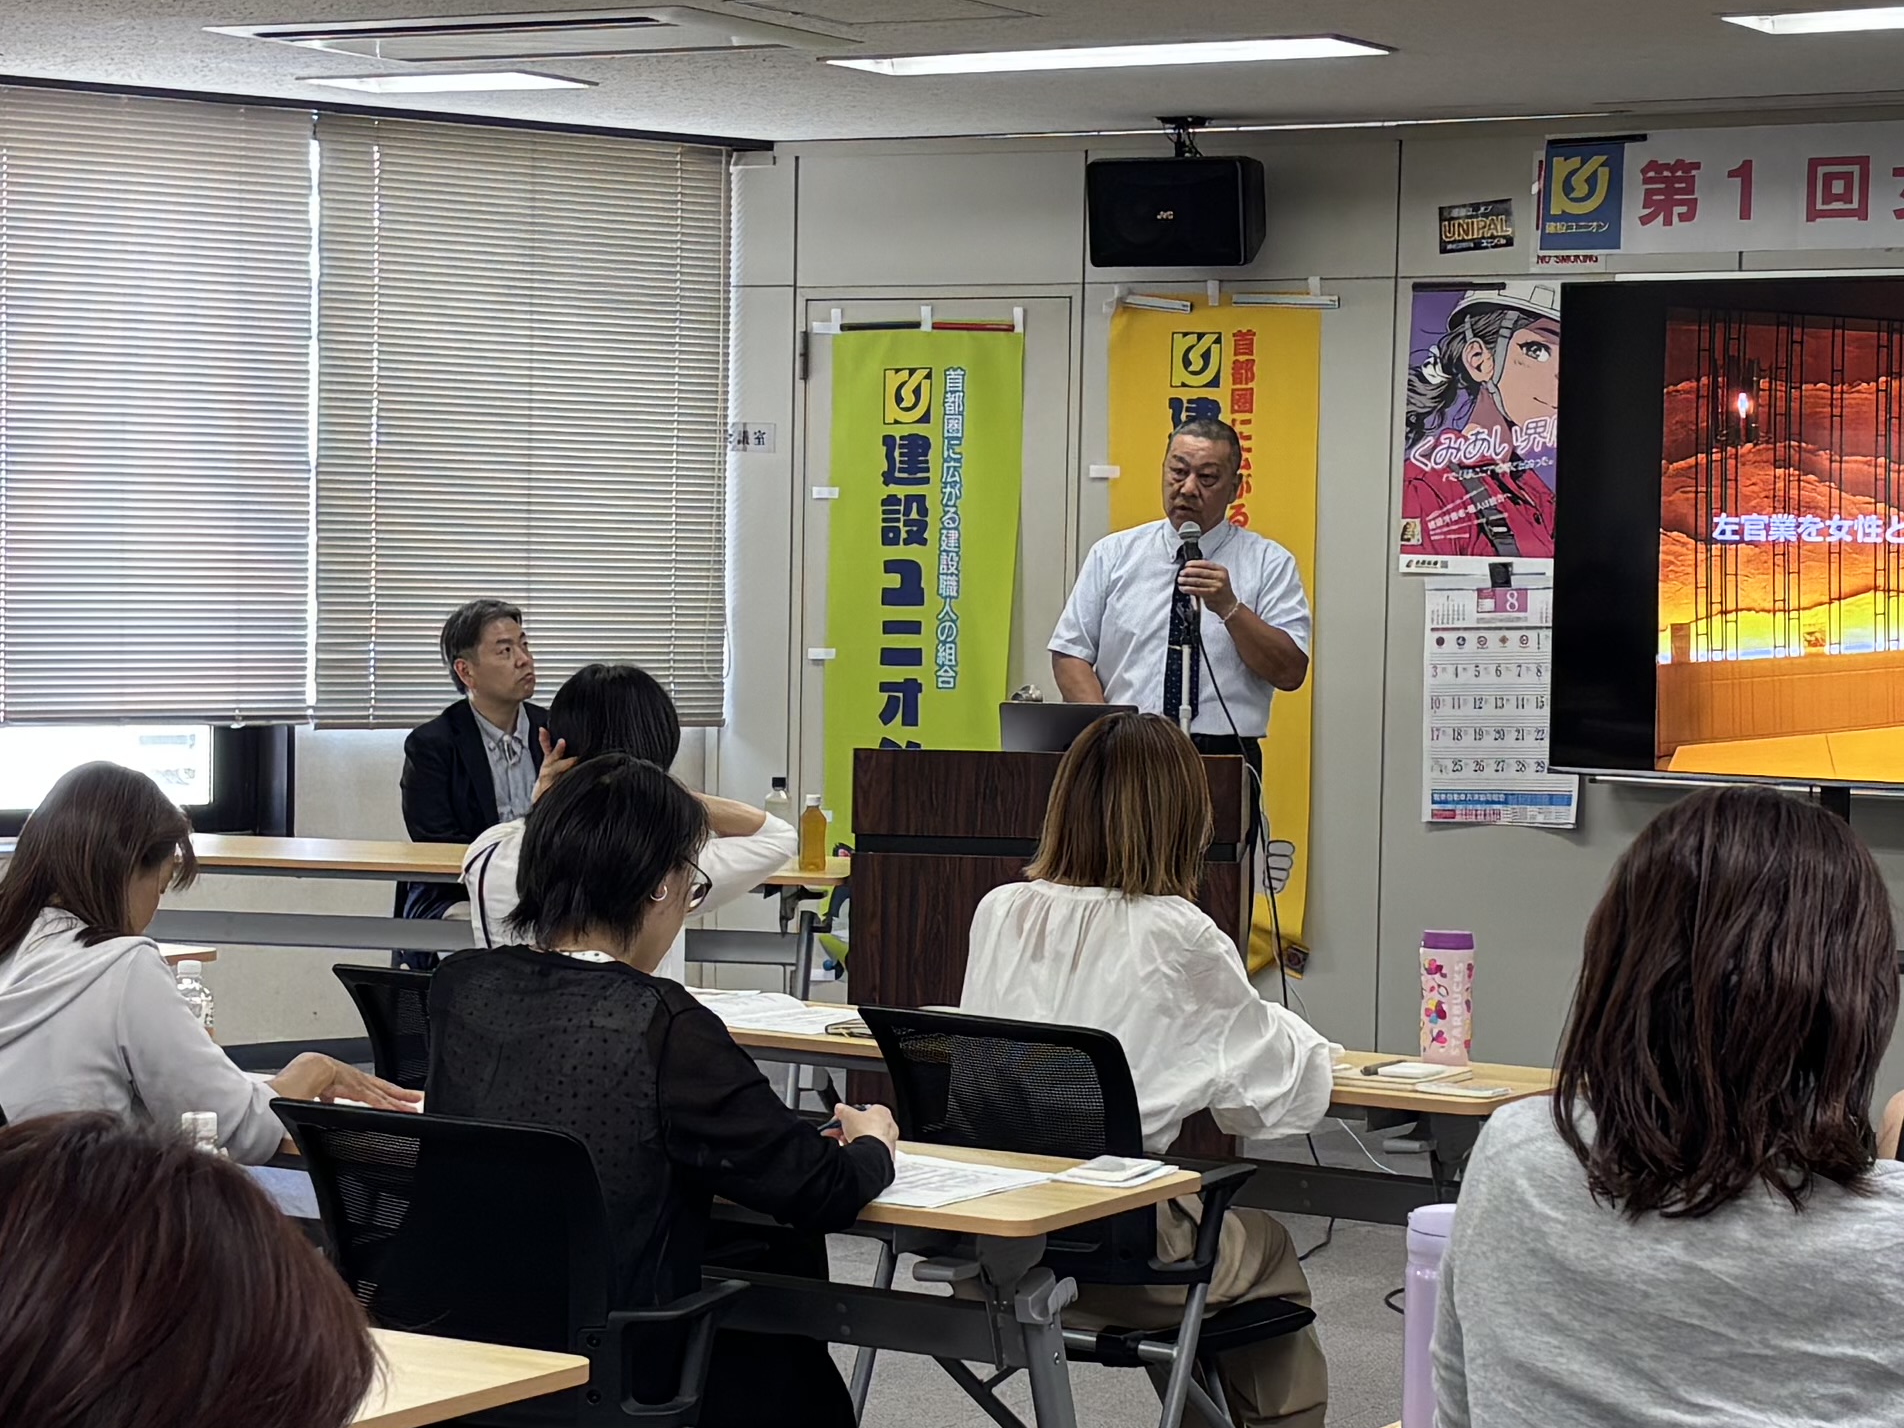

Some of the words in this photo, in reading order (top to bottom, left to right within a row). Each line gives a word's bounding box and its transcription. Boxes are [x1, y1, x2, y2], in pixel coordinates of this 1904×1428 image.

[1442, 215, 1513, 242] UNIPAL
[1545, 221, 1610, 234] 建設ユニオン
[1410, 421, 1558, 471] くみあい界
[935, 367, 966, 690] 首都圏に広がる建設職人の組合
[878, 433, 933, 749] 建設ユニオ
[1505, 590, 1519, 612] 8
[1432, 665, 1438, 678] 3
[1474, 665, 1480, 678] 5
[1495, 665, 1502, 678] 6
[1516, 665, 1522, 678] 7
[1431, 697, 1441, 710] 10
[1452, 697, 1461, 710] 11
[1474, 697, 1484, 710] 12
[1495, 697, 1504, 710] 13
[1536, 697, 1545, 710] 15
[1431, 729, 1441, 741] 17
[1452, 729, 1463, 741] 18
[1474, 729, 1484, 741] 19
[1494, 729, 1505, 741] 20
[1515, 729, 1525, 741] 21
[1535, 729, 1545, 741] 22
[1452, 760, 1463, 773] 25
[1473, 760, 1485, 773] 26
[1495, 760, 1506, 773] 27
[1516, 760, 1527, 773] 28
[1535, 760, 1546, 773] 29
